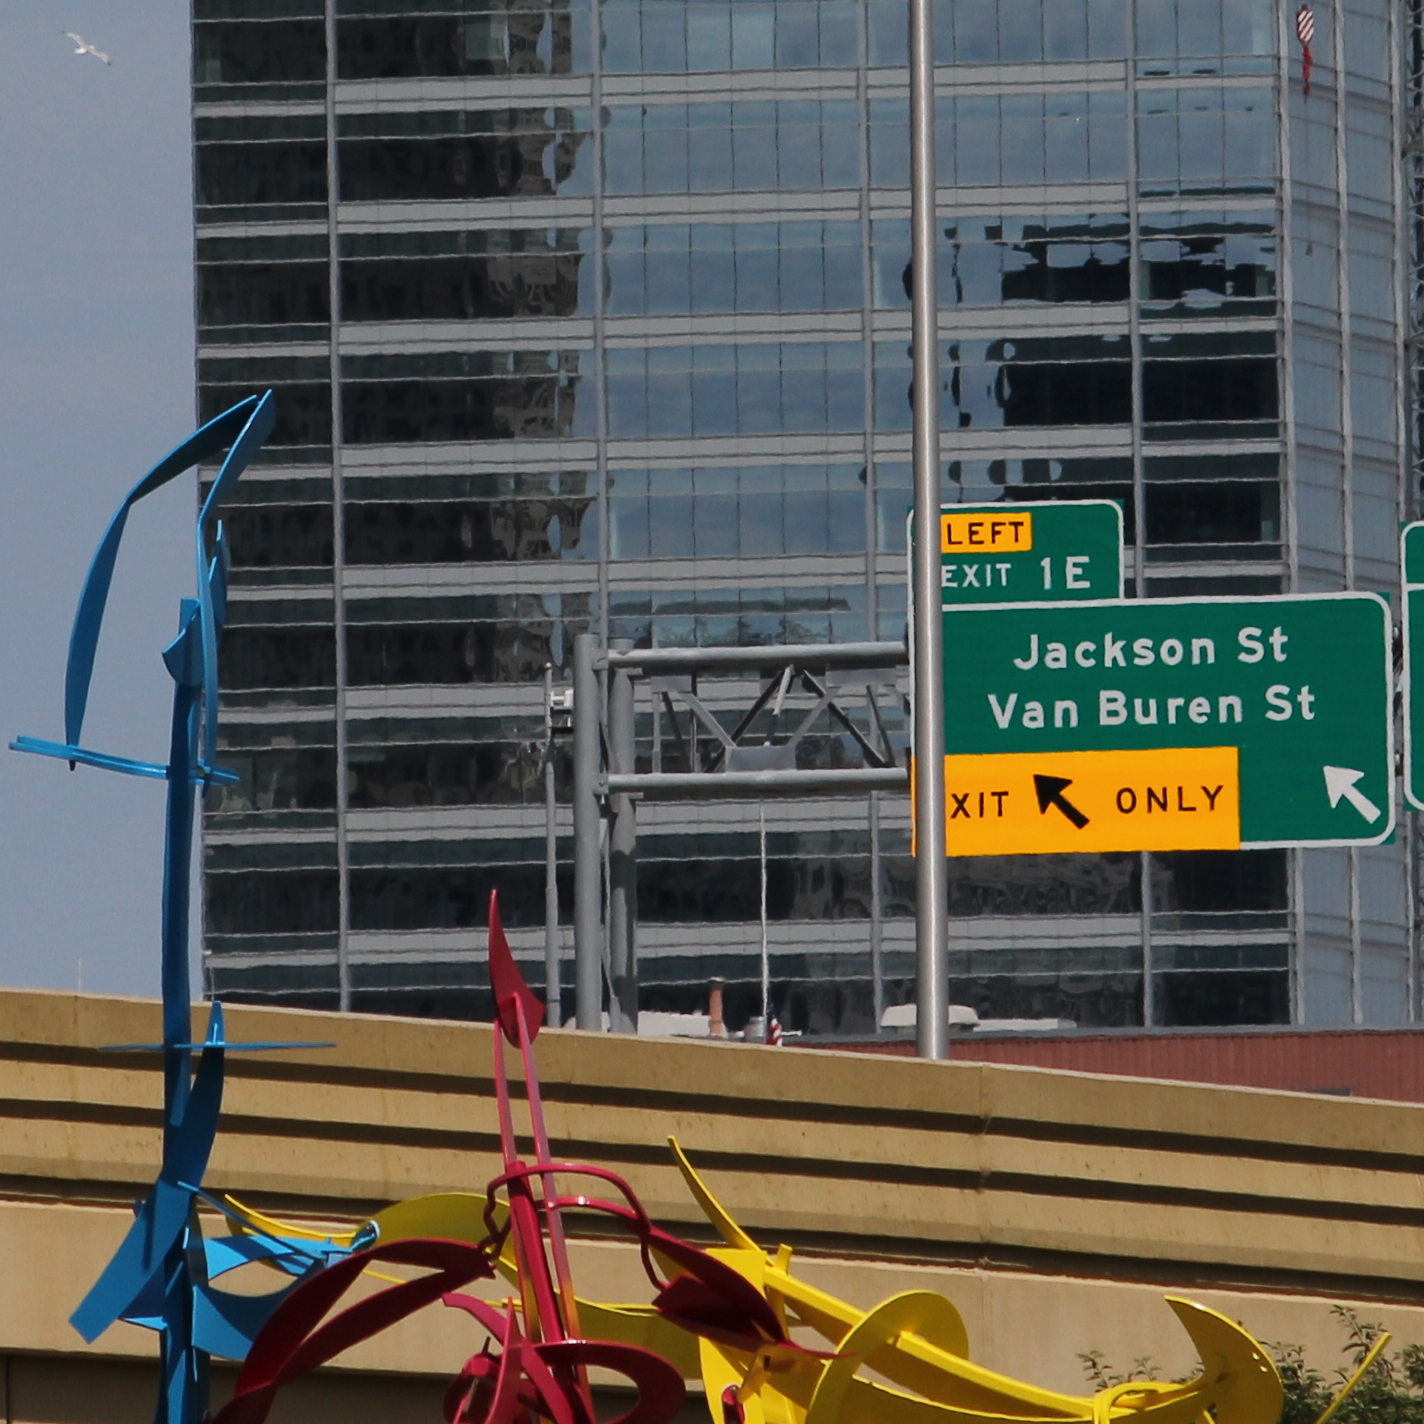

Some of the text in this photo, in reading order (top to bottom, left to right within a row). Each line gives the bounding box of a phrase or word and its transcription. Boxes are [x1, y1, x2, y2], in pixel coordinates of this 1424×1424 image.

[947, 521, 1024, 545] LEFT
[941, 563, 1011, 588] EXIT
[1013, 626, 1289, 671] Jackson St
[987, 684, 1316, 729] Van Buren St
[950, 784, 1224, 820] XIT ONLY
